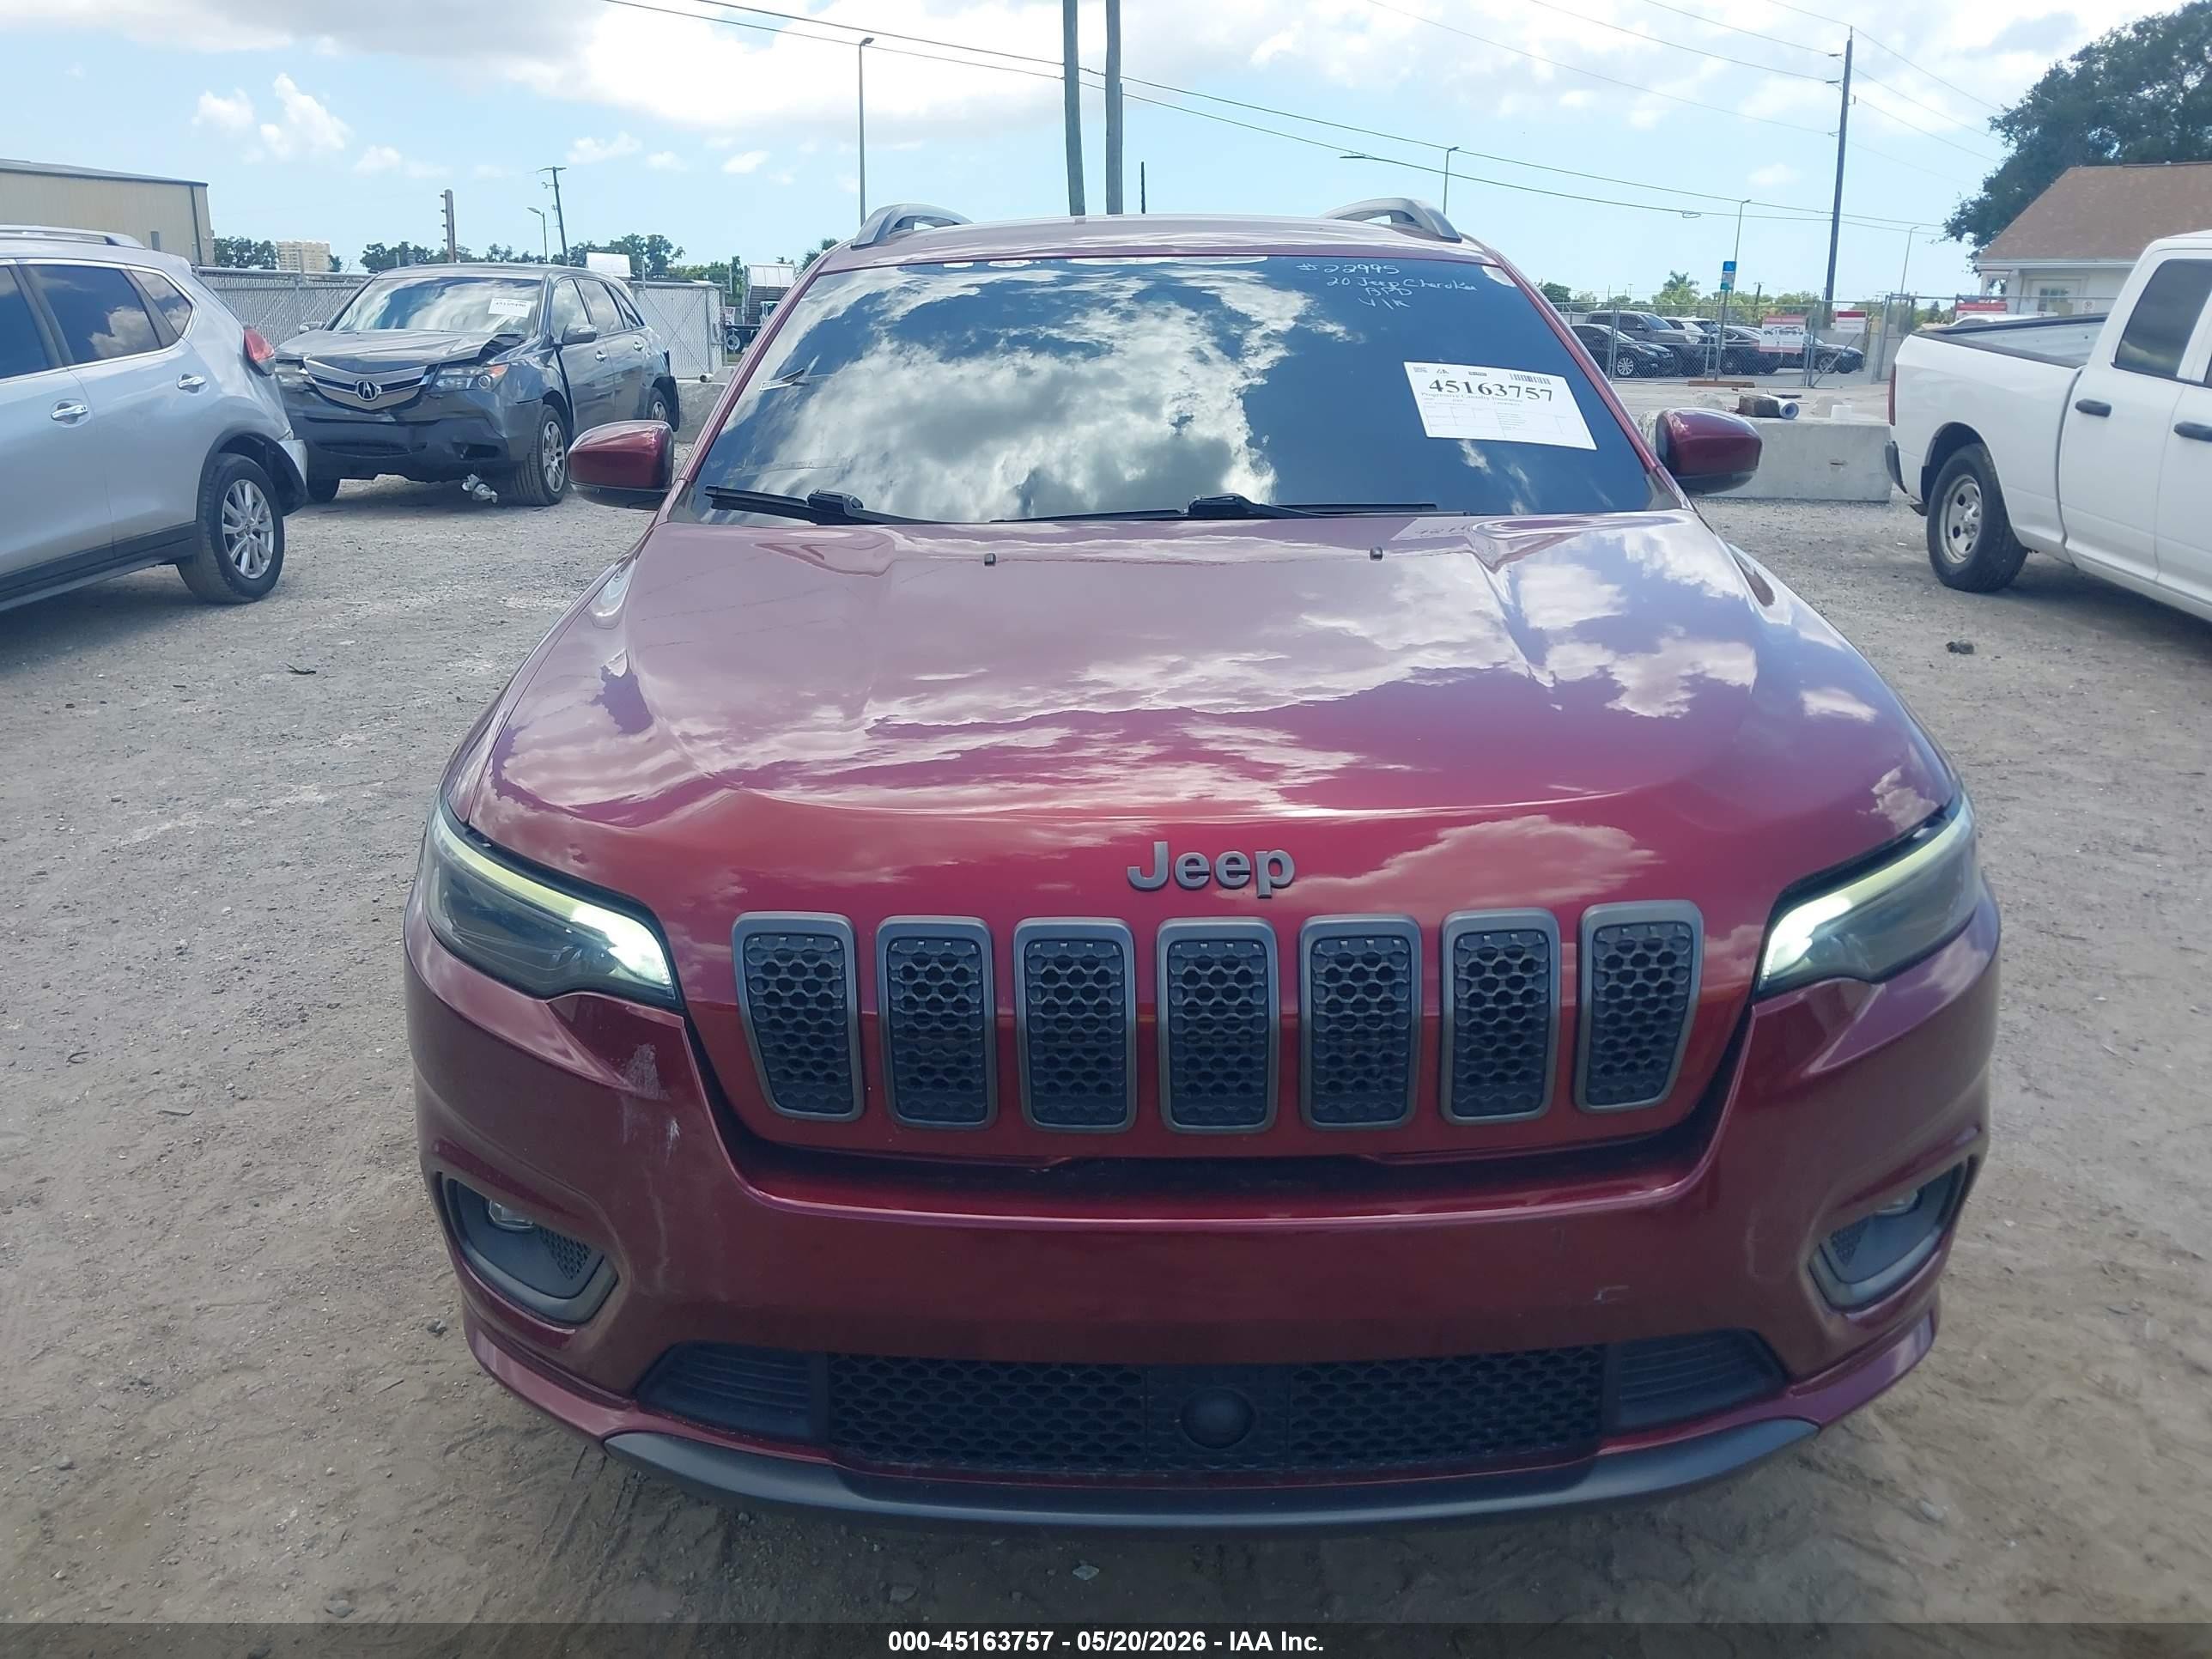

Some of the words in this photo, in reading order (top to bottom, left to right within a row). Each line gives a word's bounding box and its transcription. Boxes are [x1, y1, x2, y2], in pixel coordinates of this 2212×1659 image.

[1326, 276, 1351, 287] 20
[1429, 379, 1553, 402] 45163757
[1127, 841, 1295, 898] Jeep
